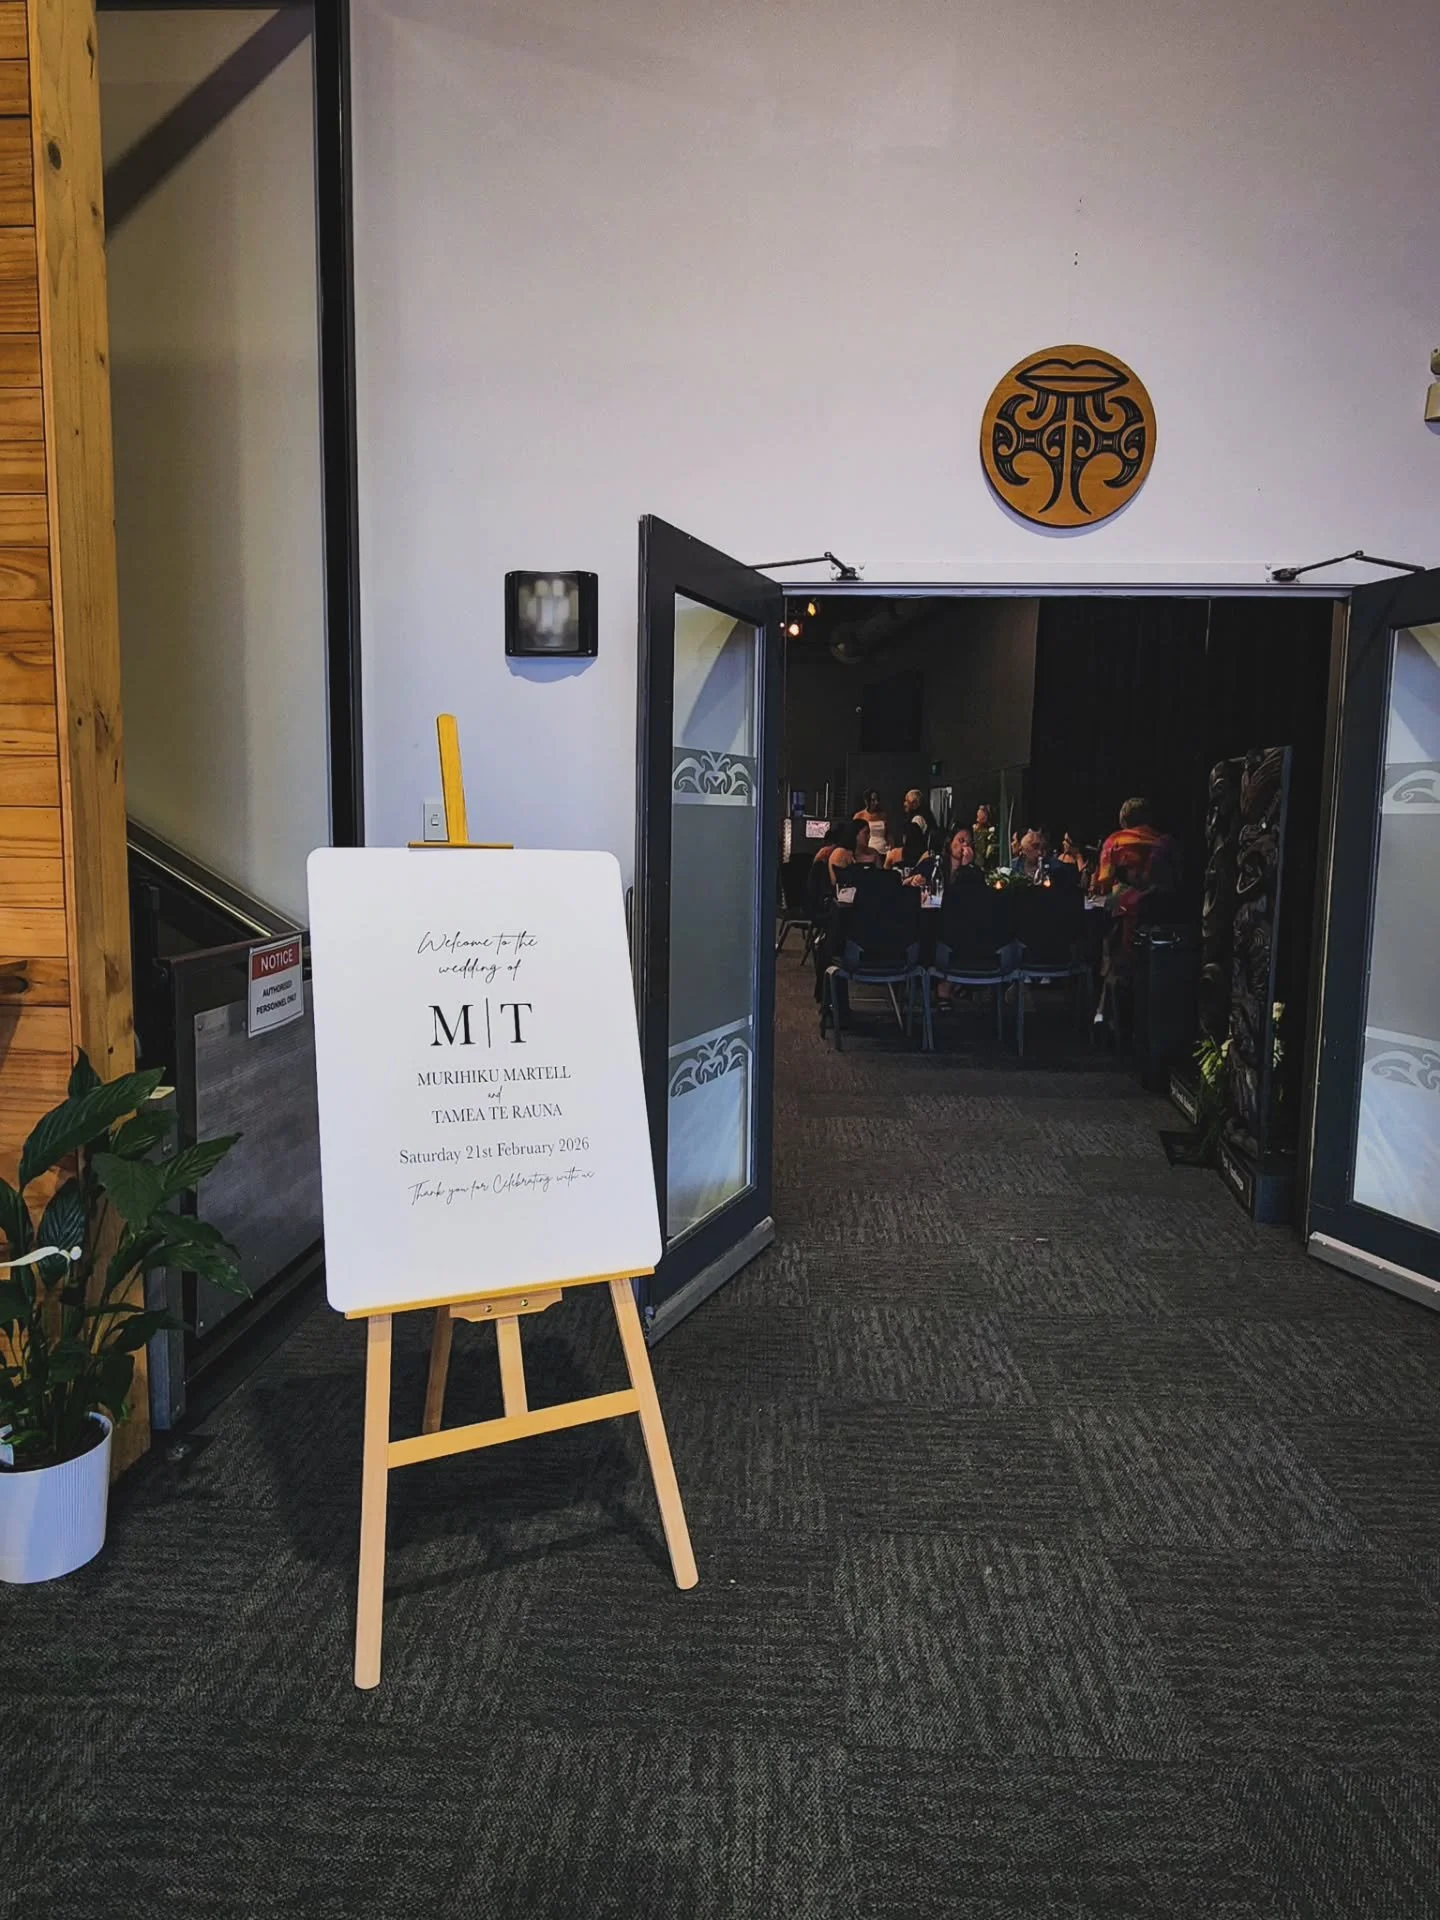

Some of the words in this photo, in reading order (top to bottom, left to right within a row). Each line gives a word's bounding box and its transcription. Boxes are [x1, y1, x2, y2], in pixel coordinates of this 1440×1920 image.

[417, 931, 493, 955] Welcome
[493, 932, 511, 955] to
[511, 930, 538, 955] the
[261, 949, 293, 972] NOTICE
[438, 958, 501, 984] wedding
[507, 959, 522, 981] of
[417, 1068, 500, 1086] MURIHIKU
[503, 1065, 571, 1082] MARTELL
[487, 1085, 503, 1103] and
[512, 1103, 563, 1119] RAUNA
[399, 1148, 462, 1165] Saturday
[465, 1145, 493, 1159] 21st
[496, 1142, 555, 1158] February
[558, 1136, 590, 1152] 2026
[407, 1179, 445, 1206] Thank
[446, 1186, 470, 1206] you
[470, 1179, 489, 1199] for
[492, 1173, 552, 1195] Celebrating
[555, 1166, 583, 1187] with
